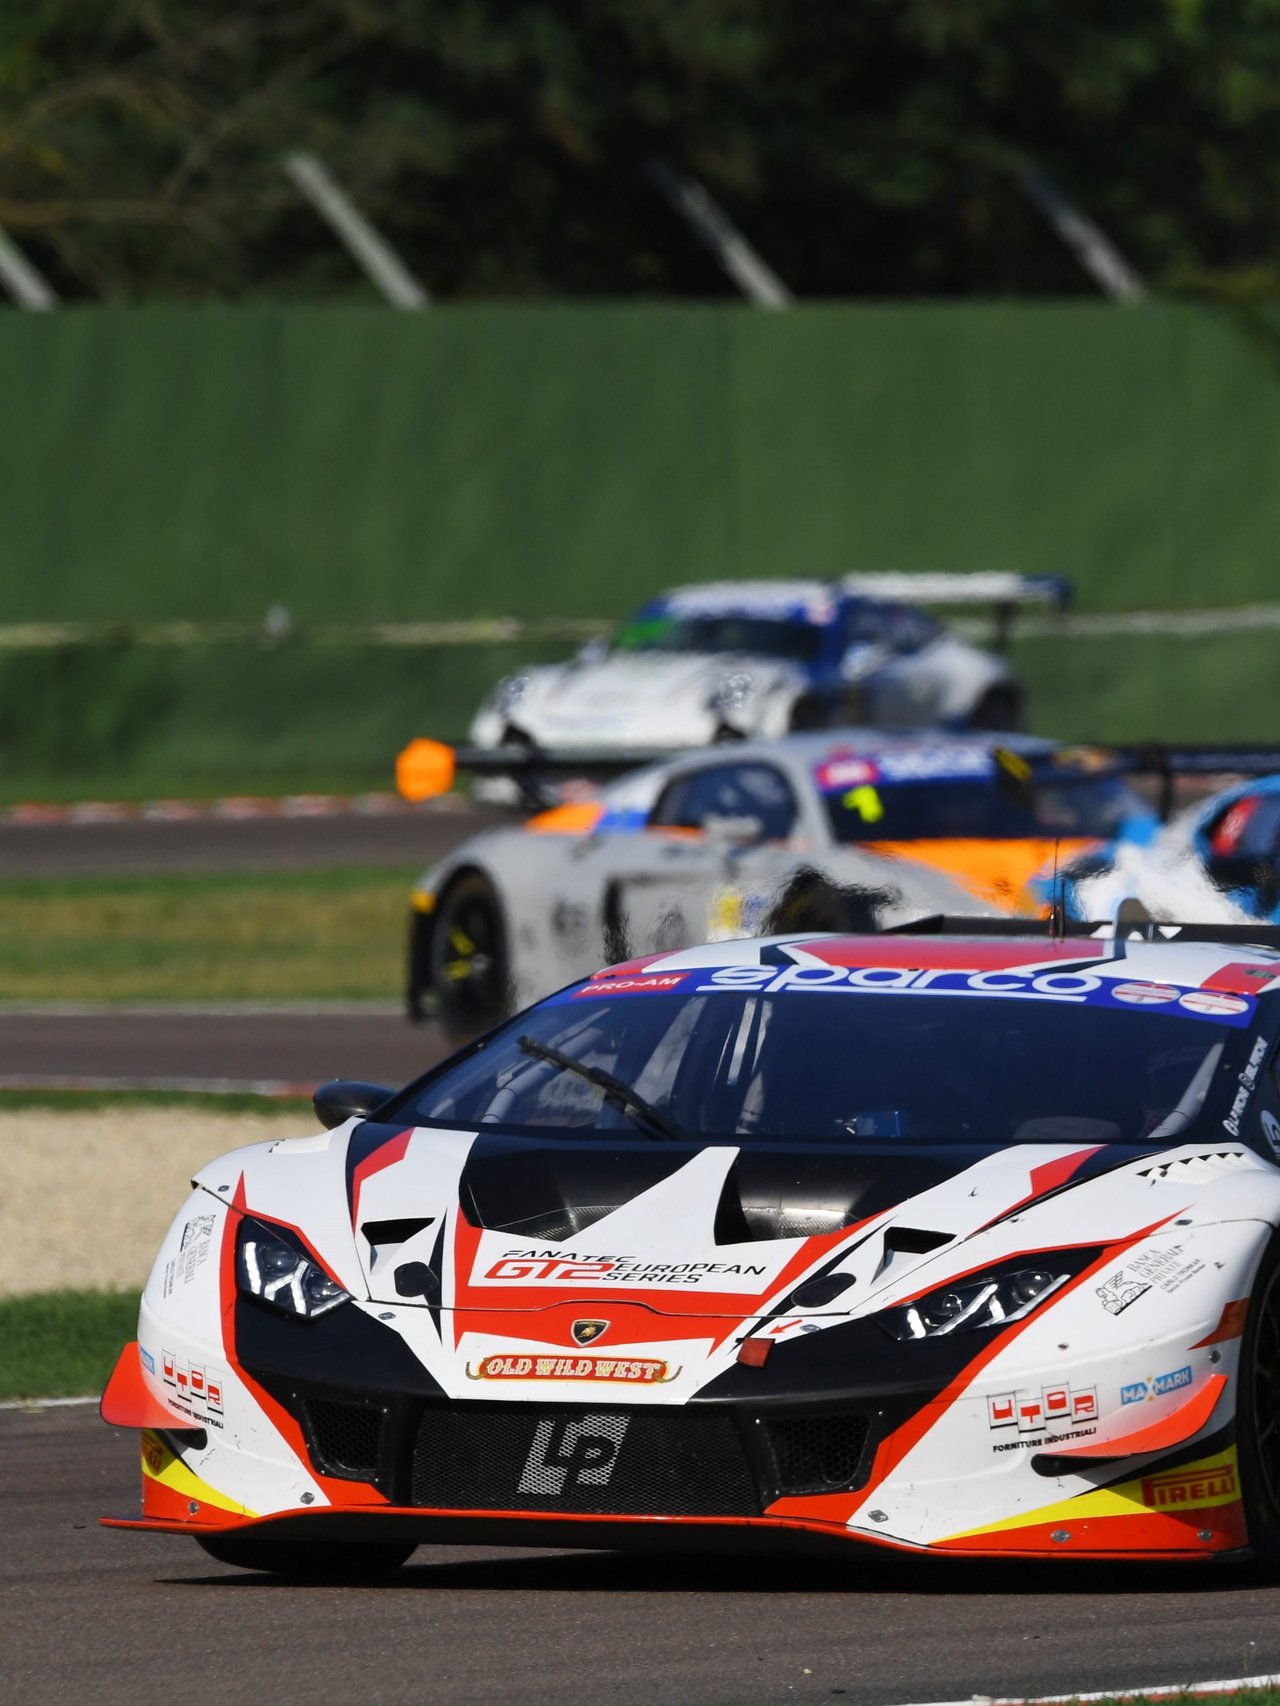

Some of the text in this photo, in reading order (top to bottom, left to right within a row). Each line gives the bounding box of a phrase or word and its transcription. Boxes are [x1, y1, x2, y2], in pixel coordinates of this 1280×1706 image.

[580, 977, 683, 993] PRO-AM
[704, 964, 1102, 995] sparco
[501, 1250, 636, 1263] FANATEC
[483, 1259, 767, 1280] GT2 EUROPEAN
[602, 1272, 703, 1283] SERIES
[163, 1356, 222, 1406] UTOR
[486, 1358, 662, 1380] OLD WILD WEST
[991, 1389, 1096, 1425] UTOR
[992, 1427, 1097, 1453] FORNITURE INDUSTRIALI
[1141, 1464, 1236, 1508] PIRELLI
